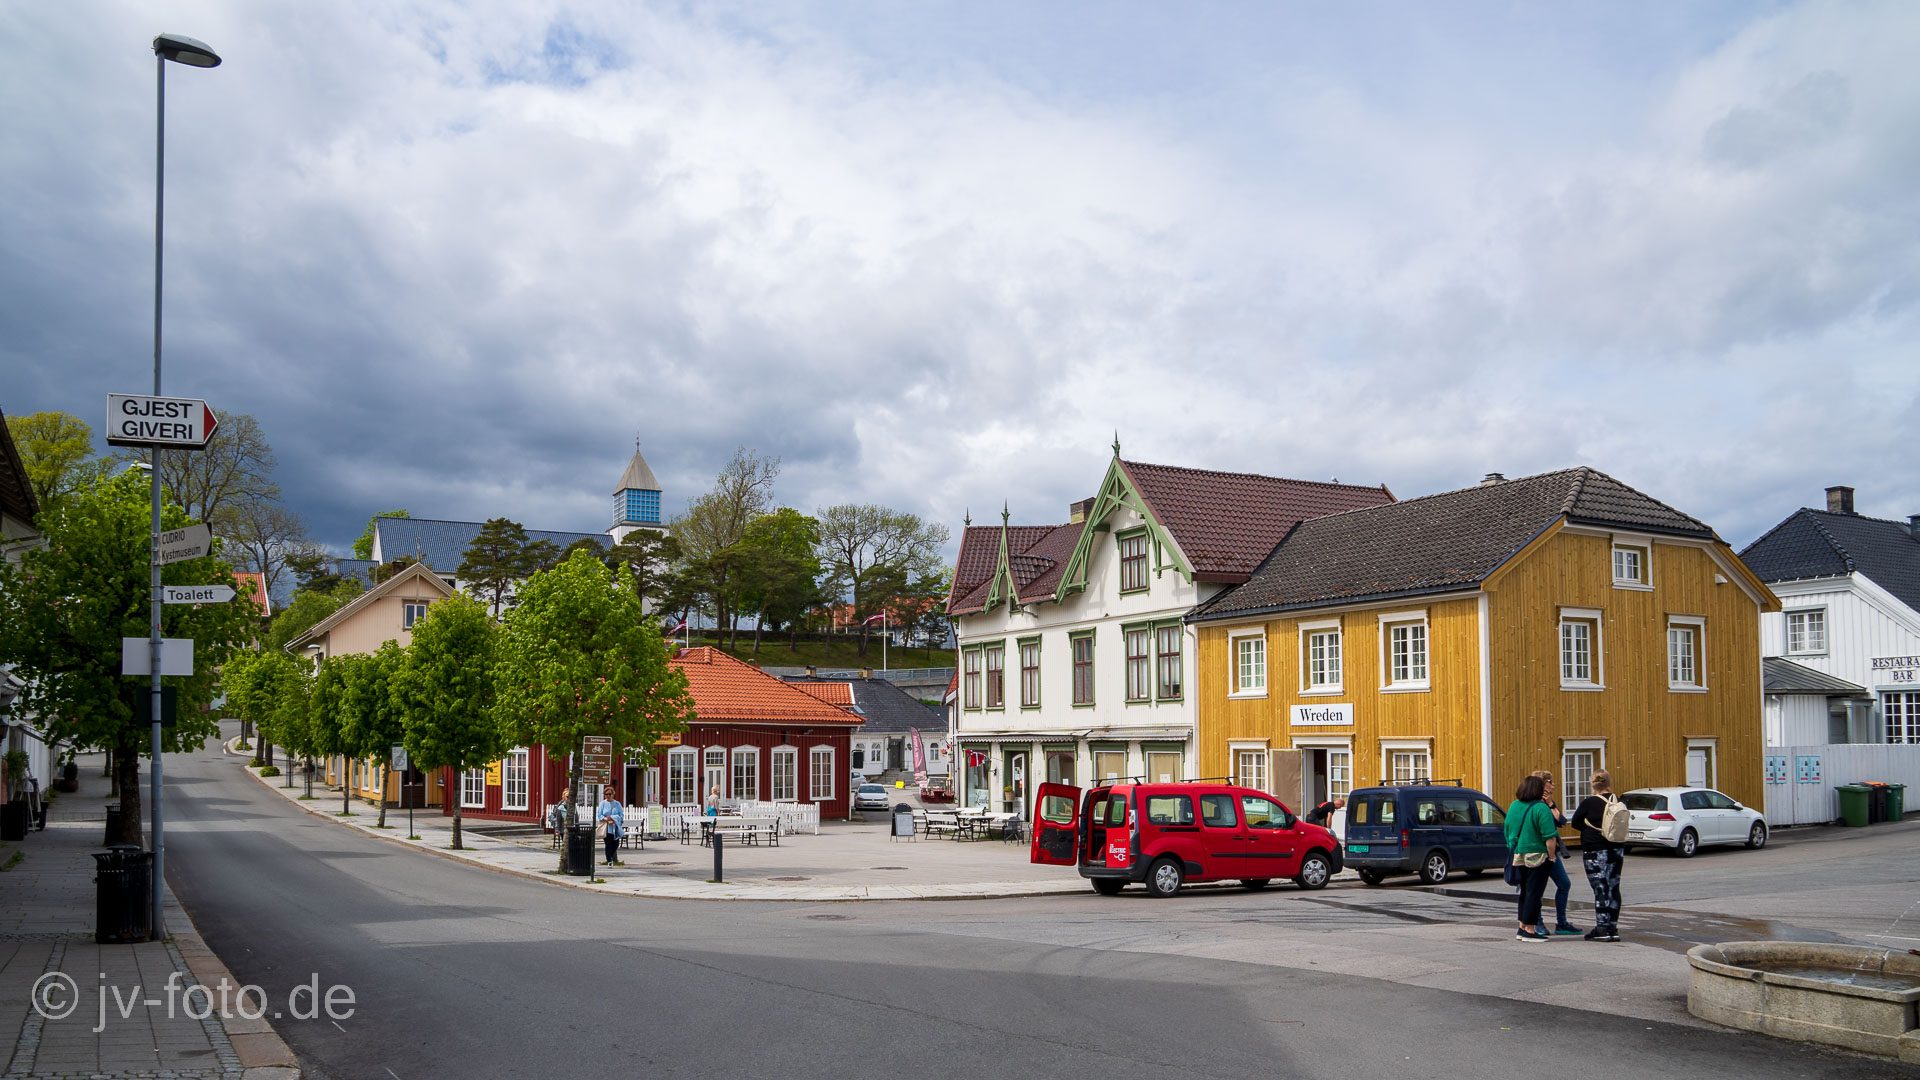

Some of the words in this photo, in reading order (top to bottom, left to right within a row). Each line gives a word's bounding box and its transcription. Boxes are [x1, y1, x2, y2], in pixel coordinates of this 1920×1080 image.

[122, 399, 193, 419] GJEST
[122, 420, 193, 440] GIVERI
[162, 530, 186, 545] CUDRIO
[162, 546, 202, 563] Kystmuseum
[167, 589, 214, 601] Toalett
[1893, 671, 1913, 680] BAR
[1299, 708, 1343, 721] Wreden
